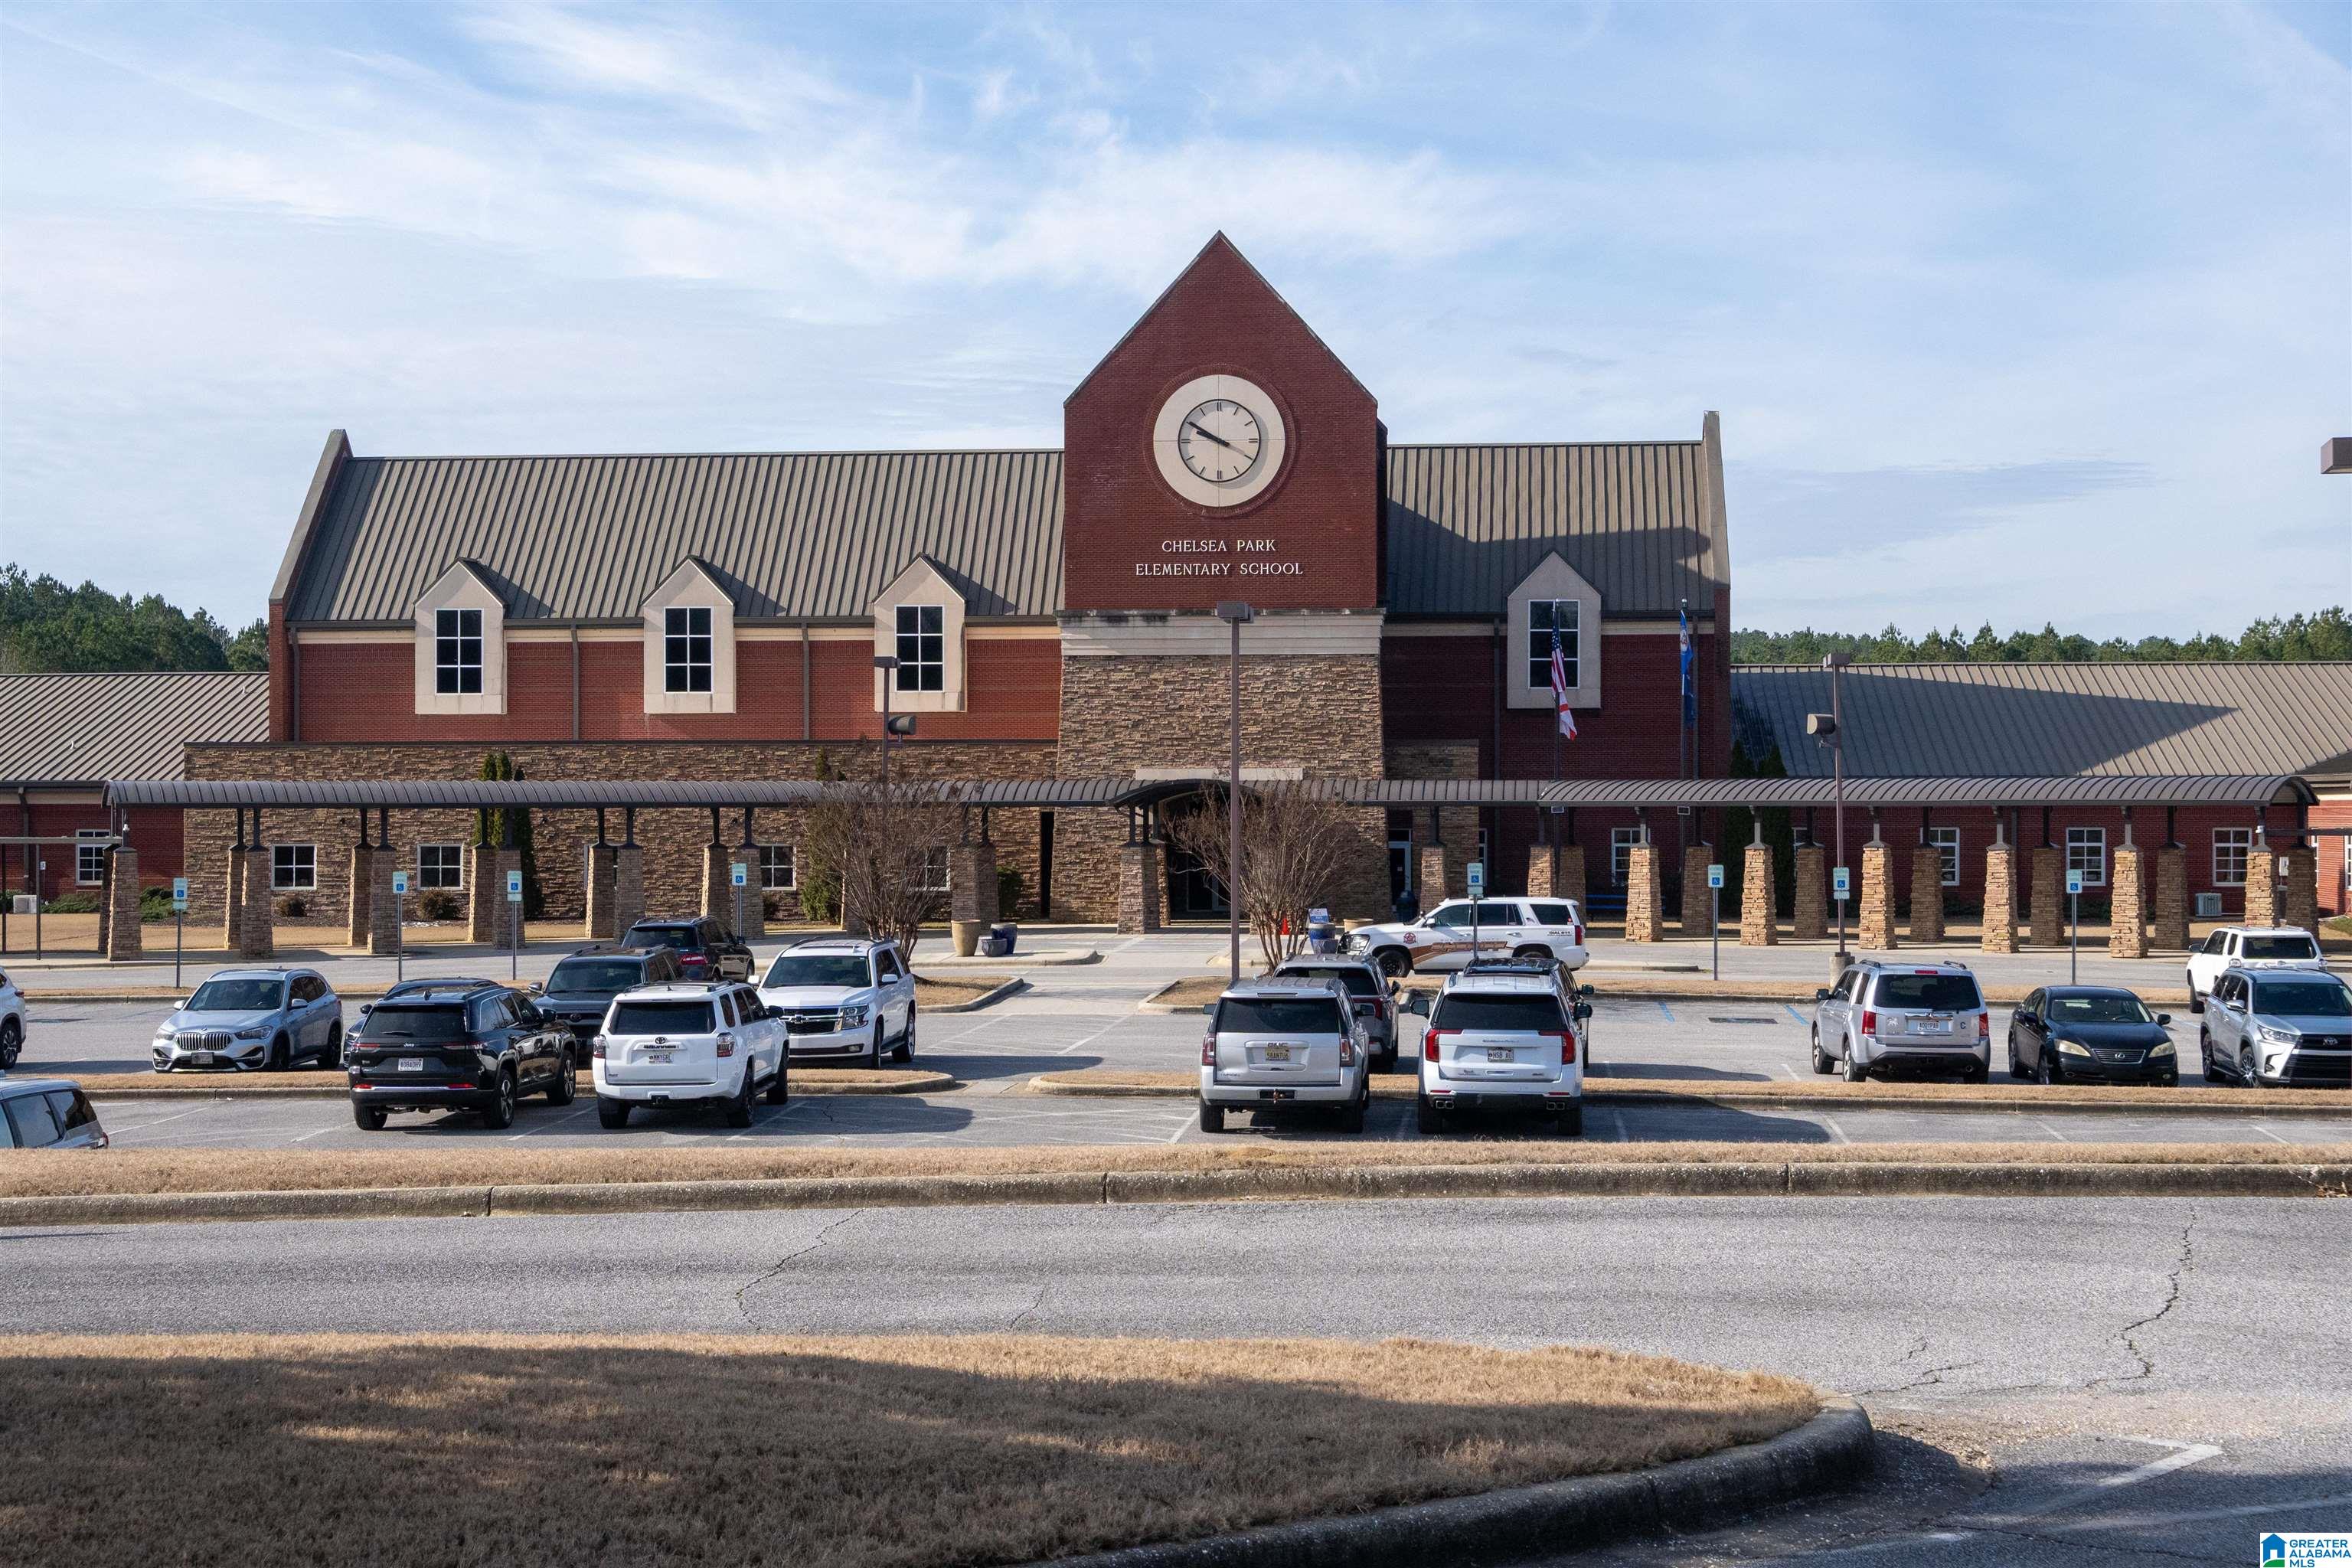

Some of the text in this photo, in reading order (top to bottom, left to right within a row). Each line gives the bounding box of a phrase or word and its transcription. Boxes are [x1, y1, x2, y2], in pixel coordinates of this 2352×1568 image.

[1161, 539, 1276, 552] CHELSEA PARK
[1135, 562, 1304, 576] ELEMENTARY SCHOOL
